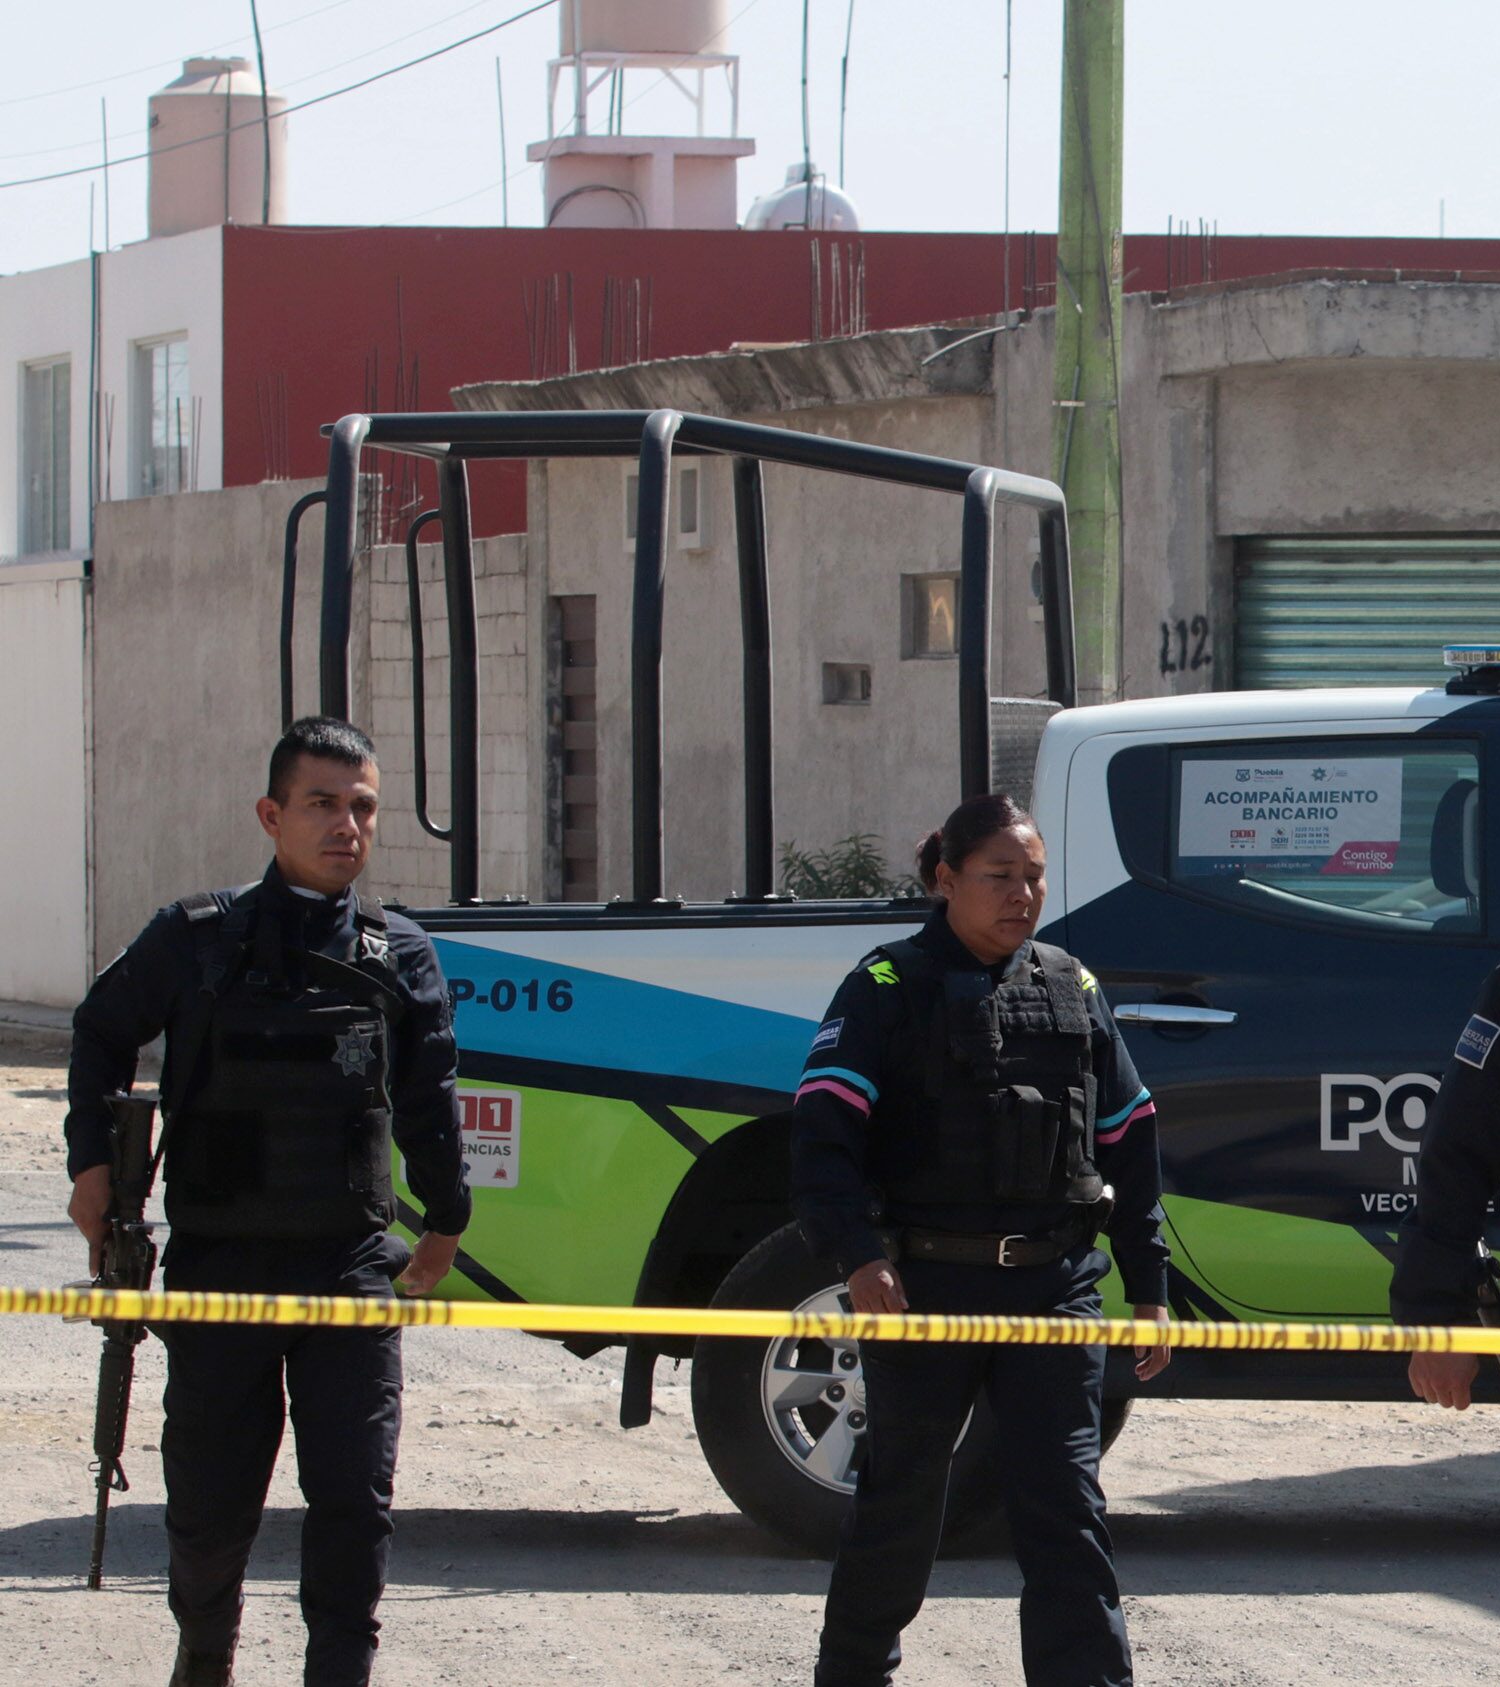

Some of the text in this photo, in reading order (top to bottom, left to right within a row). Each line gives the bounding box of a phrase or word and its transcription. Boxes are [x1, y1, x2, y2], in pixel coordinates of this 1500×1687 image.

[1204, 787, 1378, 805] ACOMPAÑAMIENTO
[1242, 807, 1338, 820] BANCARIO
[1231, 830, 1255, 838] 911
[1342, 849, 1388, 862] Contigo
[1356, 860, 1393, 870] rumbo
[459, 1100, 501, 1127] 11
[1320, 1072, 1442, 1153] PO
[462, 1143, 511, 1156] ENCIAS
[1360, 1193, 1418, 1212] VECT
